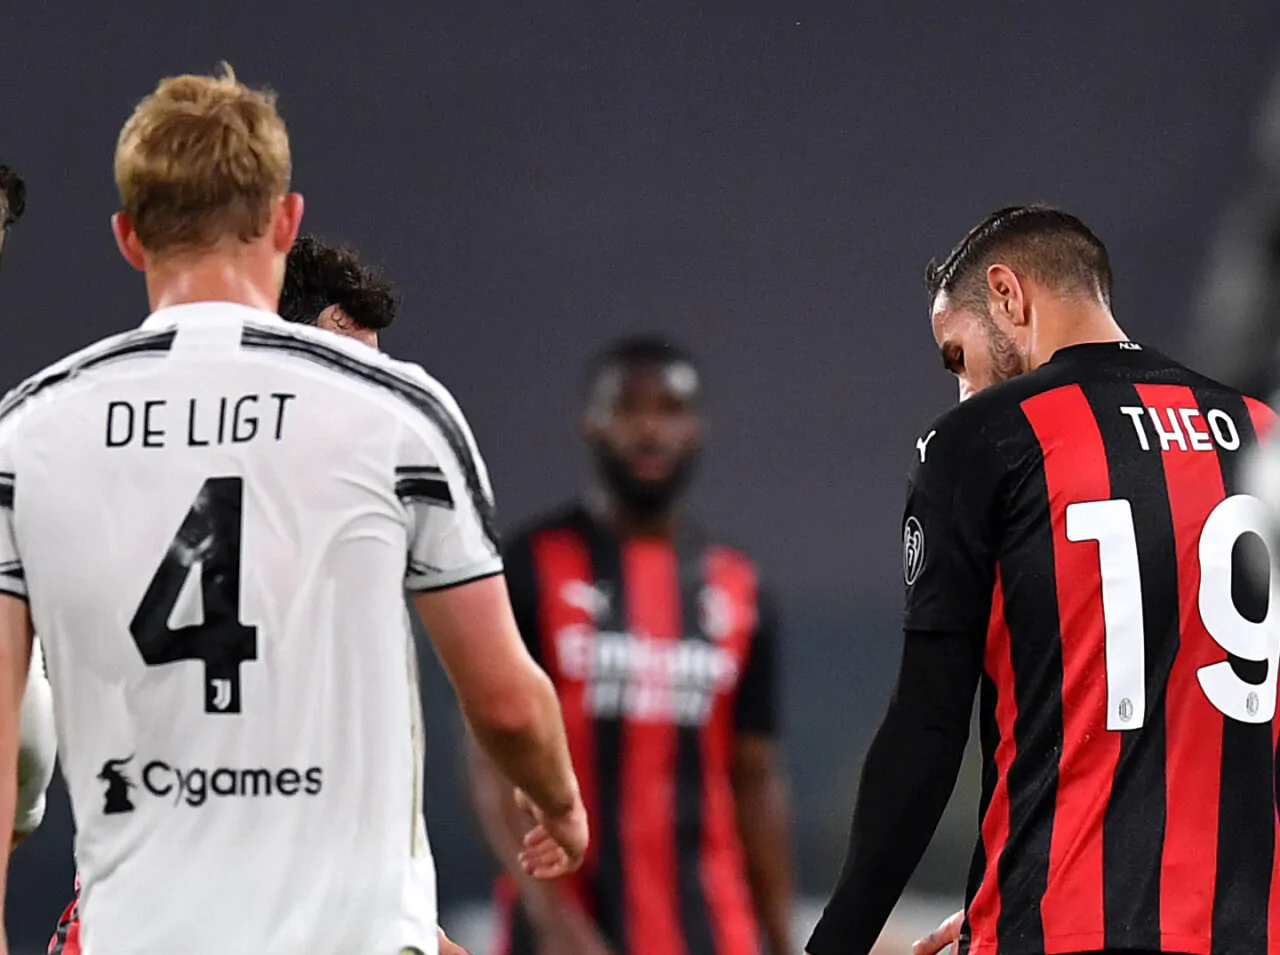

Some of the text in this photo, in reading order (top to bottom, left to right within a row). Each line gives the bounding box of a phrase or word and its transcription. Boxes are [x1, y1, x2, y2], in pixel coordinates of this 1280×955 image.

[106, 393, 295, 448] DE LIGT
[1120, 405, 1240, 452] THEO
[129, 476, 257, 714] 4
[1065, 494, 1280, 732] 19
[142, 760, 323, 808] Cygames
